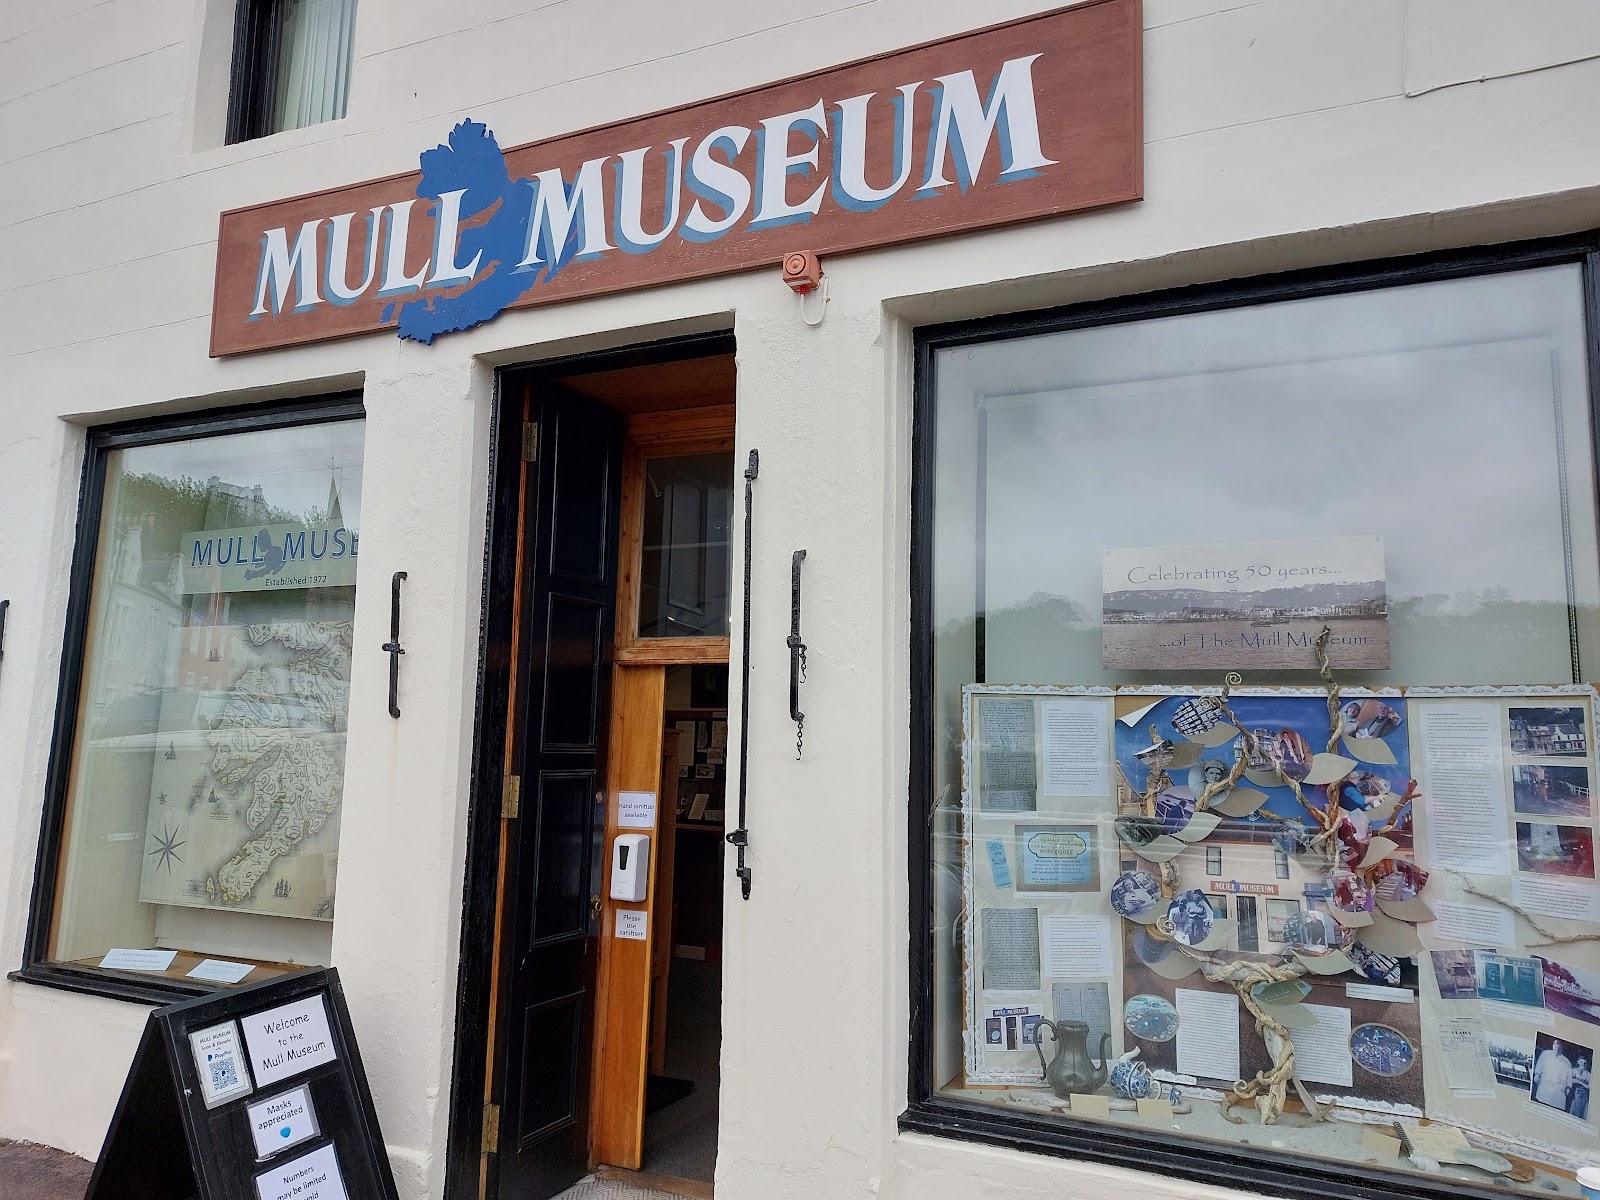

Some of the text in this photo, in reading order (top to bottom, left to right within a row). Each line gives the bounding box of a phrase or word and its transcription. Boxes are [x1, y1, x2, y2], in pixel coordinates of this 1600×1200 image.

[246, 52, 1060, 321] MULL MUSEUM
[190, 534, 265, 567] MULL
[265, 575, 327, 587] Established 1972
[1127, 565, 1239, 584] Celebrating
[1246, 564, 1272, 579] 50
[1200, 631, 1235, 648] The
[1240, 631, 1281, 648] Mull
[1214, 882, 1274, 894] MULL MUSEUM
[264, 1014, 310, 1034] Welcome
[213, 1030, 231, 1040] MUSEUM
[278, 1032, 304, 1047] to the
[214, 1050, 232, 1059] PayPal
[262, 1040, 326, 1070] Mull Museum
[267, 1100, 292, 1115] Masks
[258, 1106, 303, 1130] appreciated
[283, 1166, 314, 1184] Numbers
[293, 1186, 302, 1194] be
[303, 1173, 326, 1189] limited
